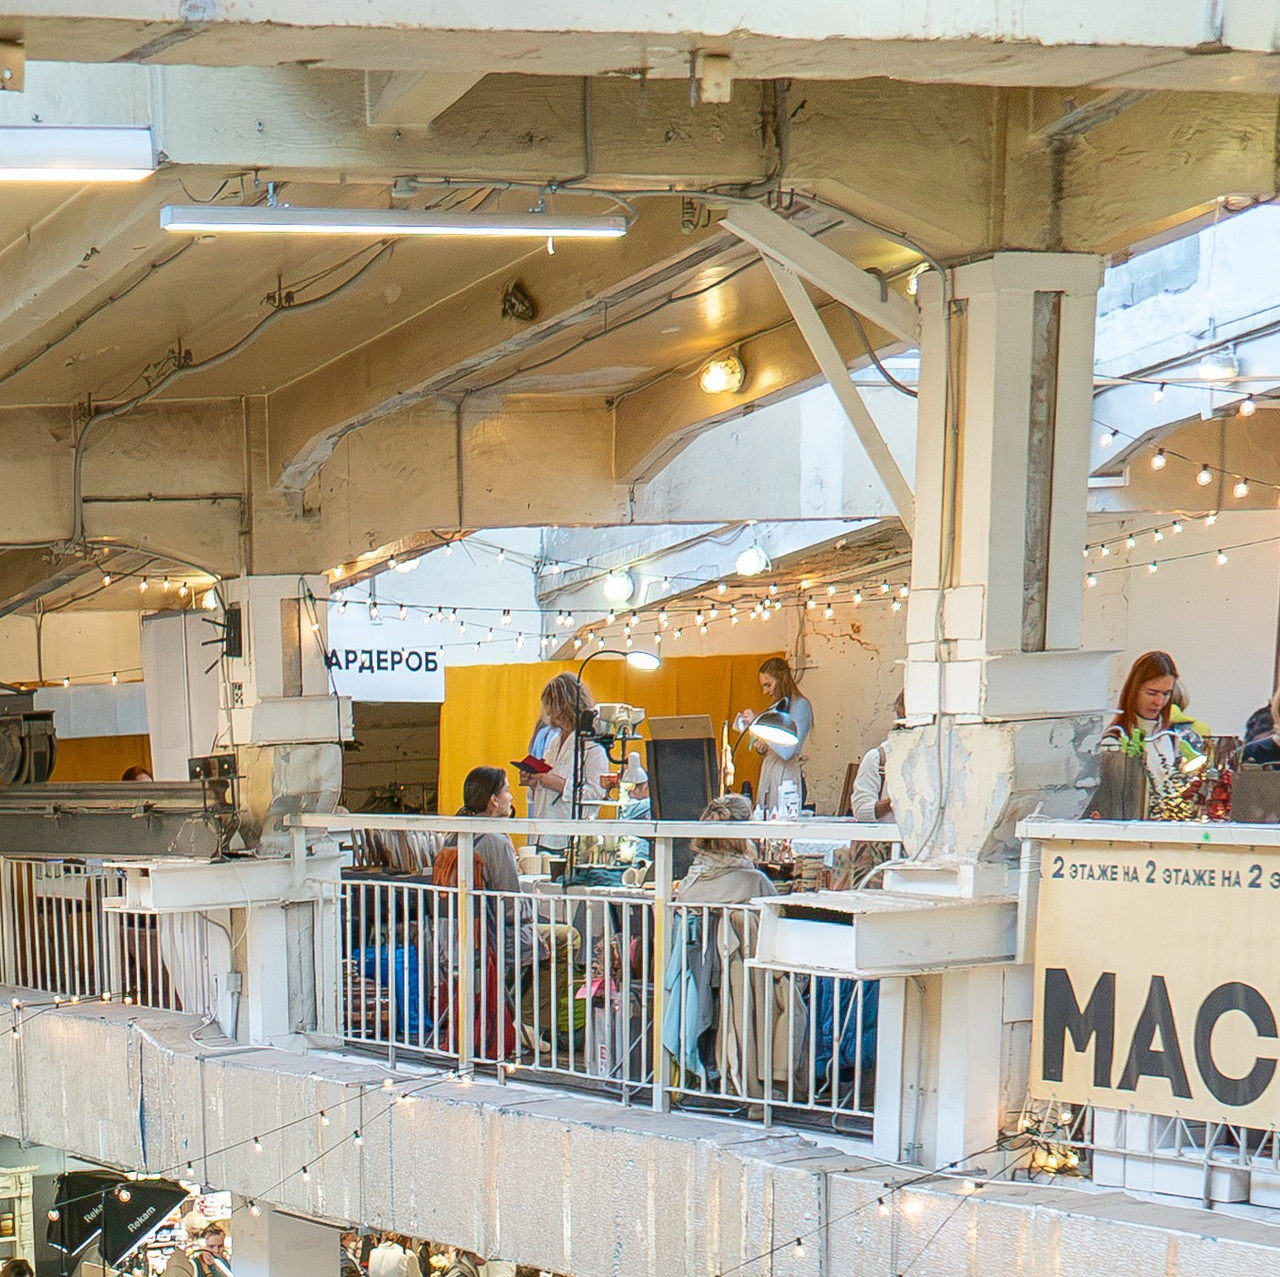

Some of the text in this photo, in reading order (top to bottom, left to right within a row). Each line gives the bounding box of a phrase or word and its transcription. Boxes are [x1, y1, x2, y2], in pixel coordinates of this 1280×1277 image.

[328, 648, 438, 674] АРДЕРОБ
[1051, 855, 1065, 879] 2
[1069, 863, 1119, 882] ЭТАЖЕ
[1122, 865, 1140, 883] НА
[1145, 860, 1157, 884] 2
[1162, 867, 1216, 887] ЭТАЖЕ
[1221, 870, 1242, 888] НА
[1247, 864, 1263, 889] 2
[1041, 967, 1280, 1107] МАС
[83, 1203, 104, 1223] Reka
[127, 1206, 156, 1233] Rekam
